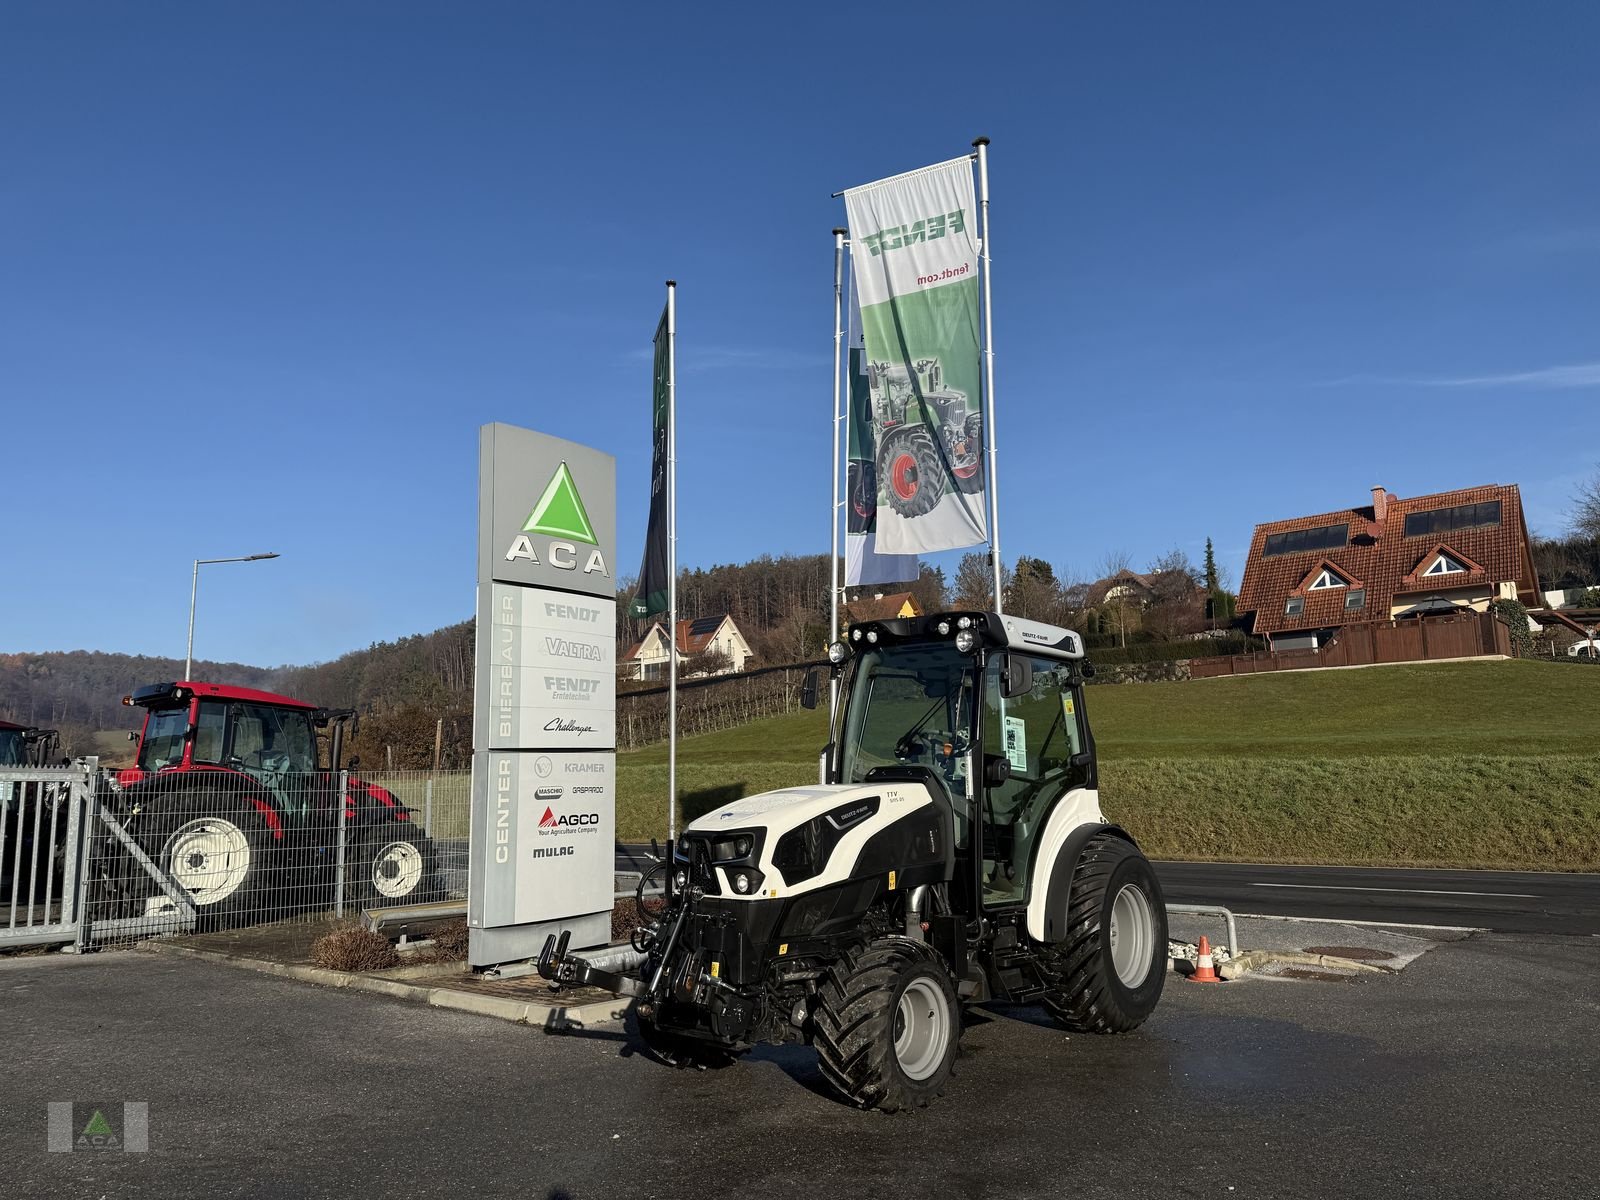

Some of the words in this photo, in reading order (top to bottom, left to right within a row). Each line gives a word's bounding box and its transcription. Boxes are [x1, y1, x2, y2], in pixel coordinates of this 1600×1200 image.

[504, 534, 610, 578] ACA
[544, 602, 601, 623] FENDT
[545, 636, 601, 662] VALTRA
[499, 595, 514, 737] BIERBAUER
[543, 676, 601, 693] FENDT
[543, 717, 599, 736] Challenger
[564, 763, 605, 773] KRAMER
[572, 786, 604, 794] GASPARDO
[495, 759, 511, 864] CENTER
[557, 813, 599, 826] AGCO
[550, 828, 577, 836] Agriculture
[577, 826, 598, 834] Company
[533, 846, 574, 858] MULAG
